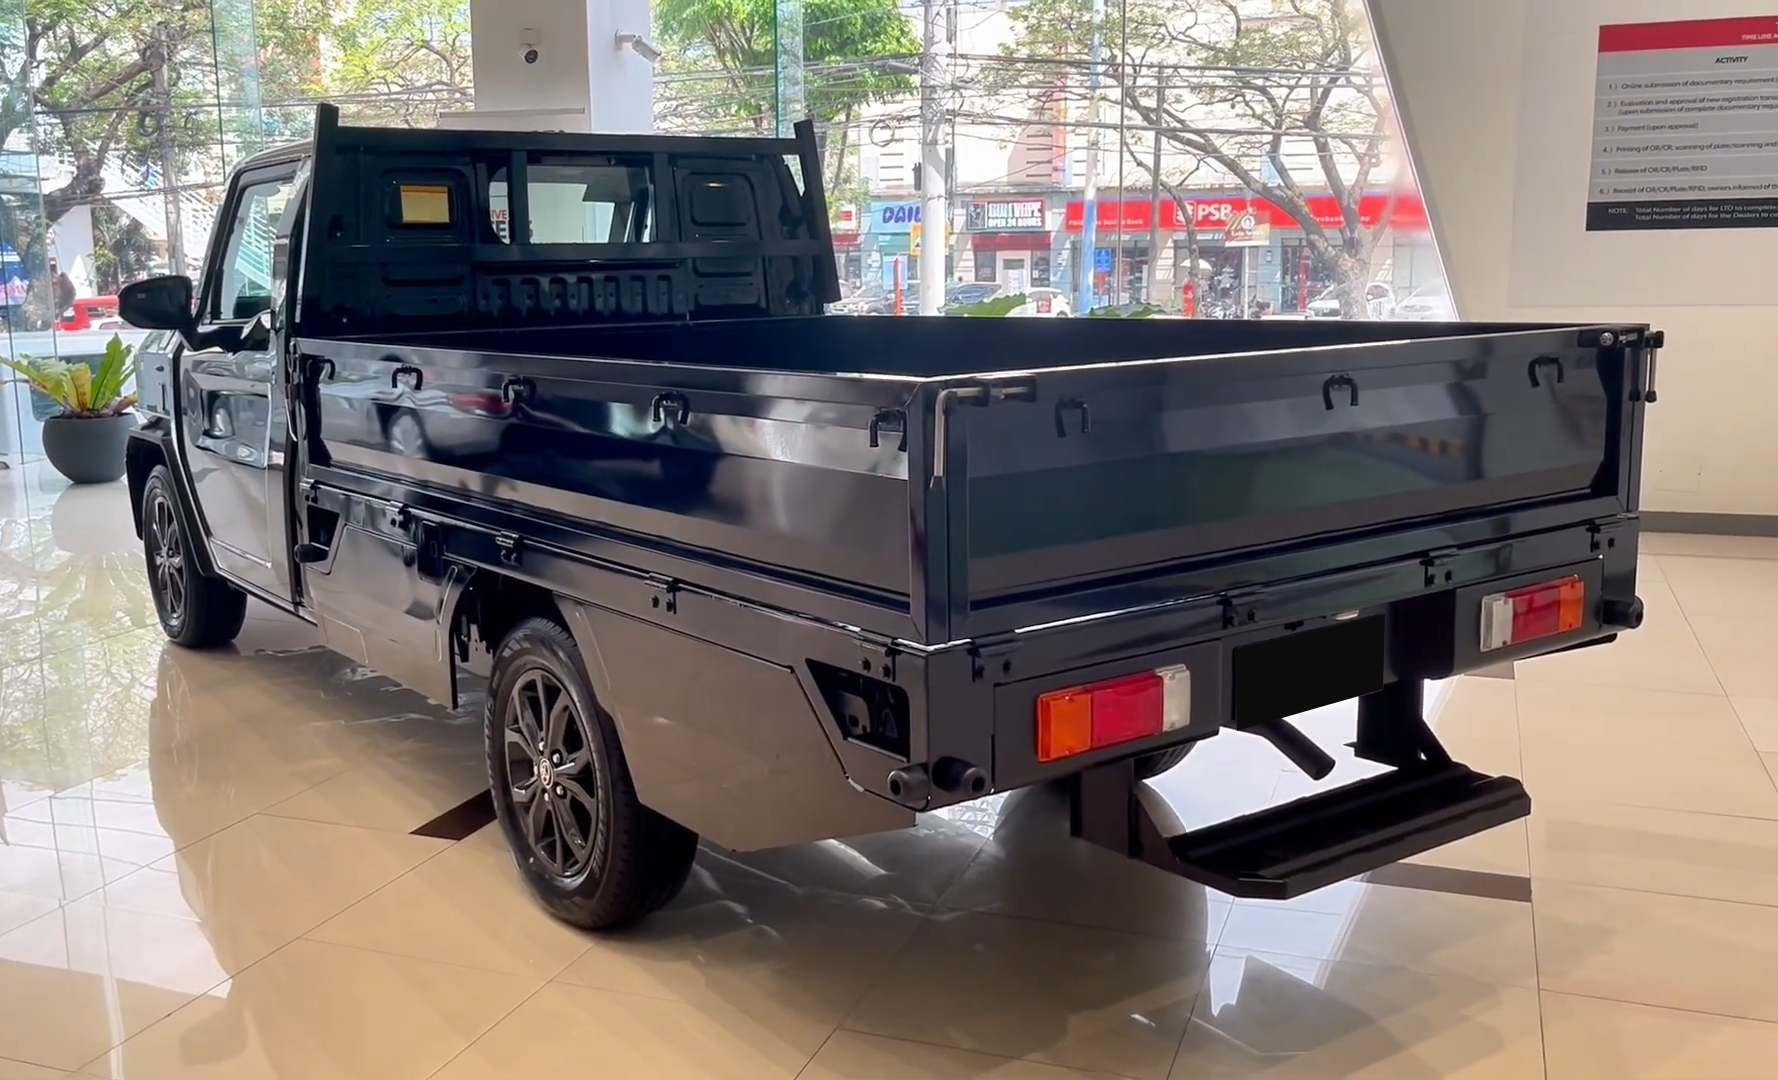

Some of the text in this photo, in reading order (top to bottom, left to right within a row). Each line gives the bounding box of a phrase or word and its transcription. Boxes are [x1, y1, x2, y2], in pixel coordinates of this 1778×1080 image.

[1714, 56, 1749, 64] ACTIVITY
[1644, 81, 1680, 89] submission
[1689, 79, 1733, 87] documentary
[1734, 77, 1775, 85] requirement
[1668, 98, 1697, 106] approval
[1721, 95, 1759, 104] registration
[1667, 122, 1699, 130] approval)
[1616, 145, 1640, 153] Printing
[1732, 183, 1762, 191] informed
[1691, 205, 1707, 213] days
[491, 209, 508, 220] IVE
[988, 217, 1042, 228] OPEN 24 HOURS
